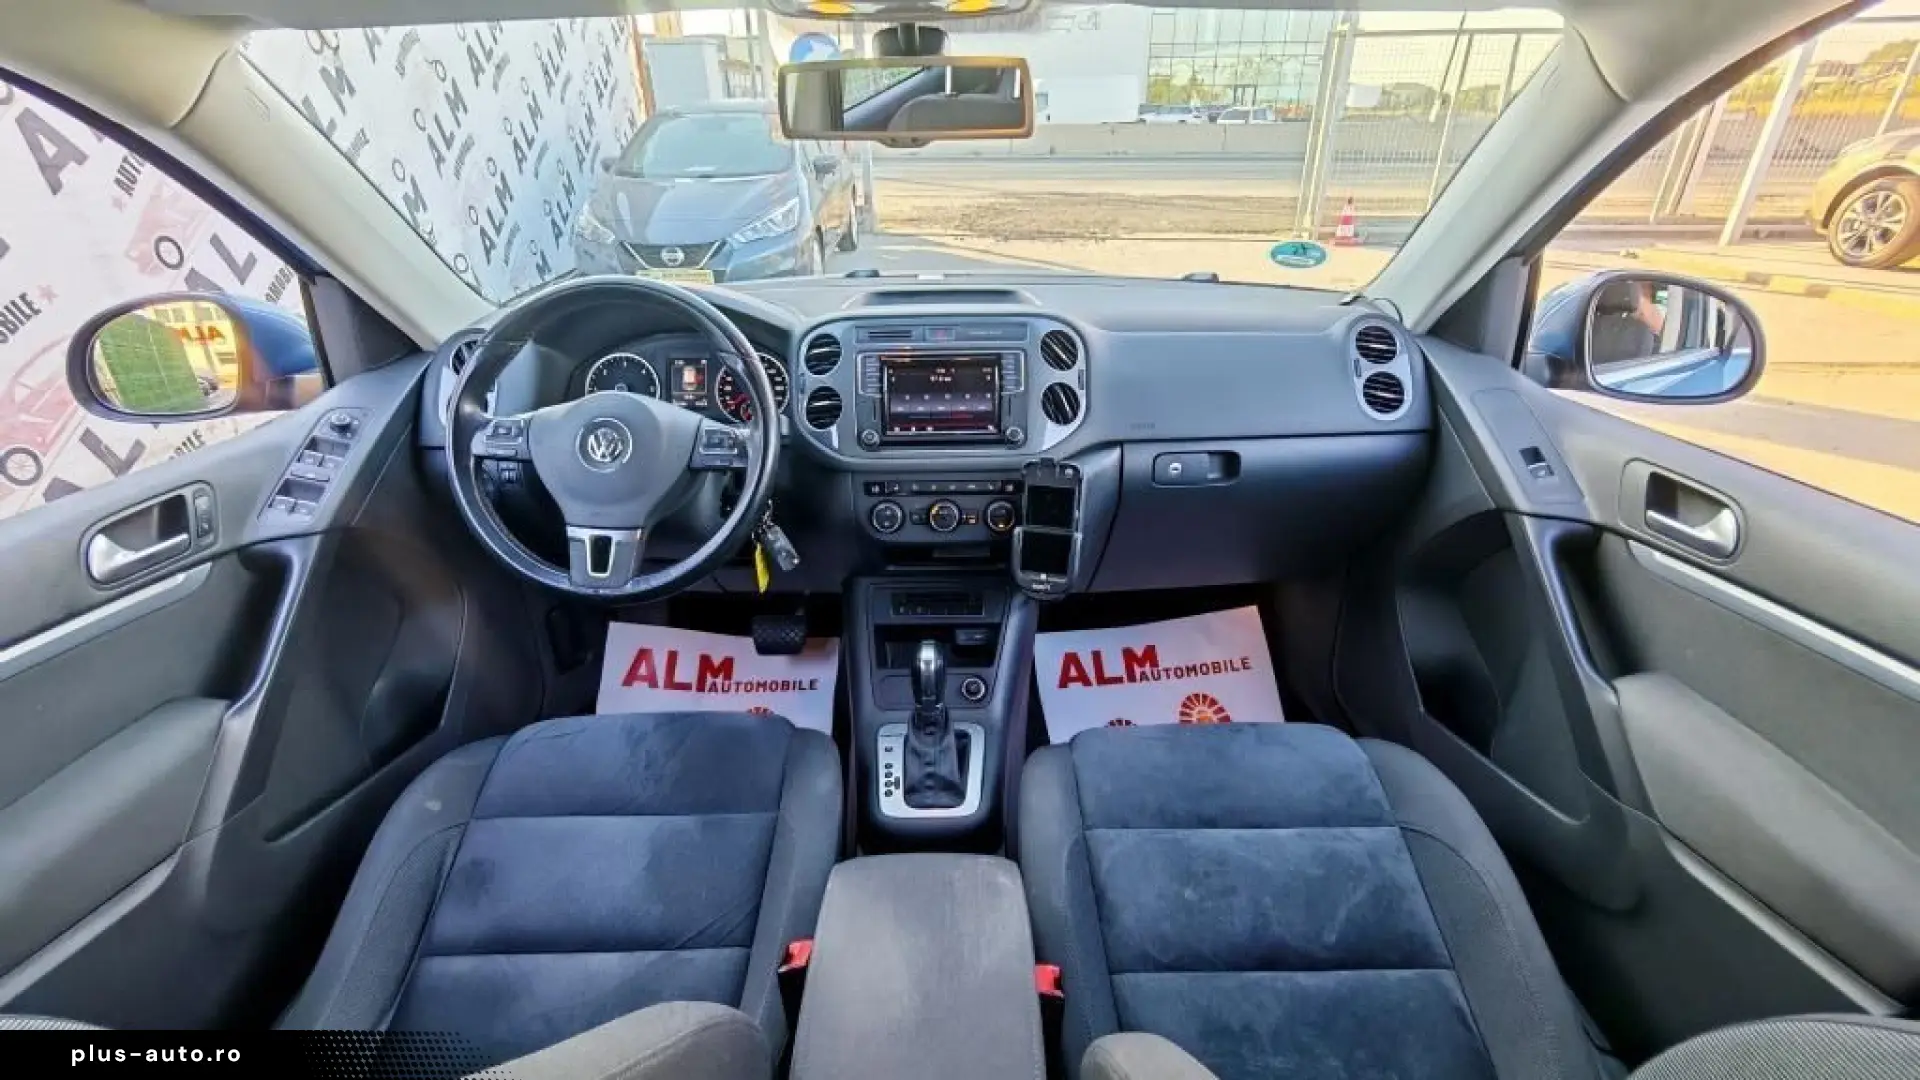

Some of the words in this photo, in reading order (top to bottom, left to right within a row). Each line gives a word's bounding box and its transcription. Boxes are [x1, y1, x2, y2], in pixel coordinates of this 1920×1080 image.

[541, 24, 566, 97] ALM
[427, 77, 468, 180] ALM
[513, 90, 544, 174] ALM
[574, 103, 596, 175] ALM
[479, 171, 514, 265] ALM
[551, 170, 576, 250] ALM
[621, 645, 736, 692] ALM
[708, 678, 819, 694] AUTOMOBILE
[1058, 644, 1160, 689] ALM
[1139, 656, 1252, 682] AUTOMOBILE
